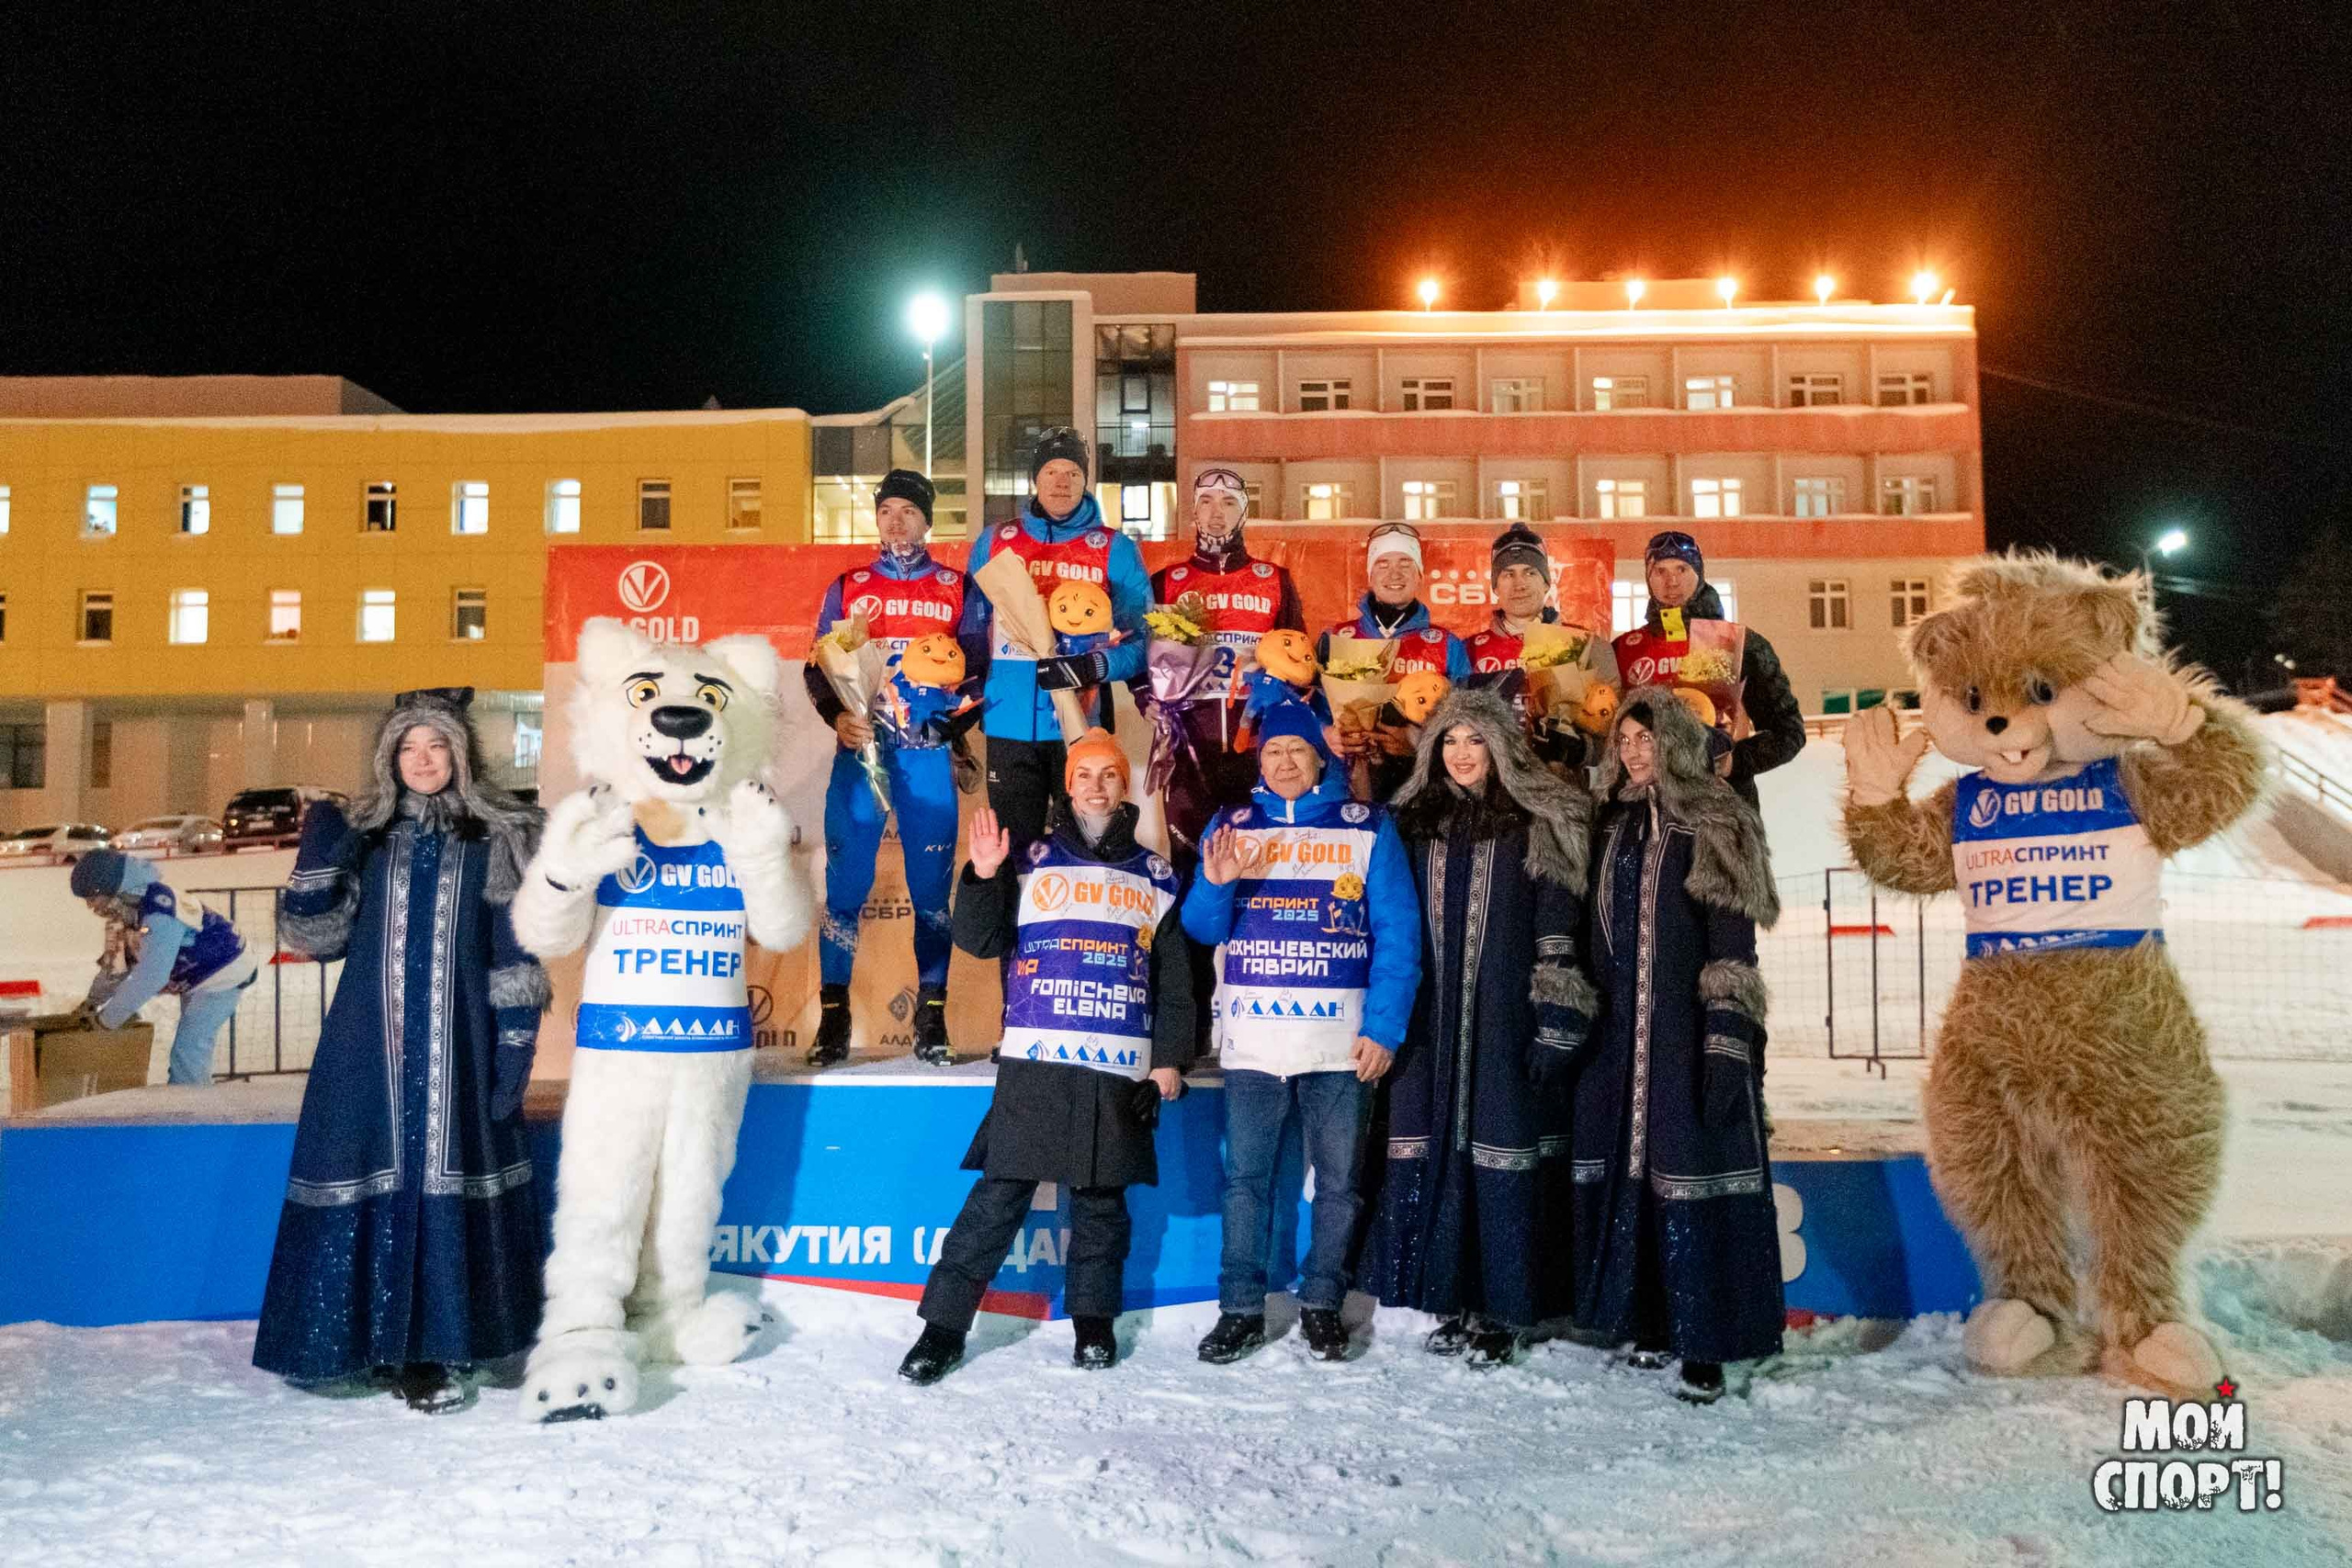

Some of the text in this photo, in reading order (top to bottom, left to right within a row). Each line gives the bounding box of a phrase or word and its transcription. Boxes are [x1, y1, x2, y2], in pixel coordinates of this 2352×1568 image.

[1029, 560, 1103, 583] GV GOLD
[1206, 594, 1272, 614] GV GOLD
[1430, 583, 1499, 604] СБ
[885, 599, 954, 622] GV GOLD
[2005, 787, 2103, 816] GV GOLD
[1266, 840, 1351, 864] GV GOLD
[1966, 845, 2109, 870] ULTRAСПРИНТ
[662, 863, 692, 886] GV
[1074, 881, 1103, 904] GV
[1108, 883, 1155, 916] GOLD
[1969, 874, 2113, 908] ТРЕНЕР
[1272, 909, 1319, 921] 2025
[613, 919, 742, 939] ULTRAСПРИНТ
[613, 948, 741, 977] ТРЕНЕР
[1082, 952, 1127, 967] 2025
[1243, 958, 1329, 976] ГАВРИЛ
[711, 1225, 891, 1264] ЯКУТИЯ
